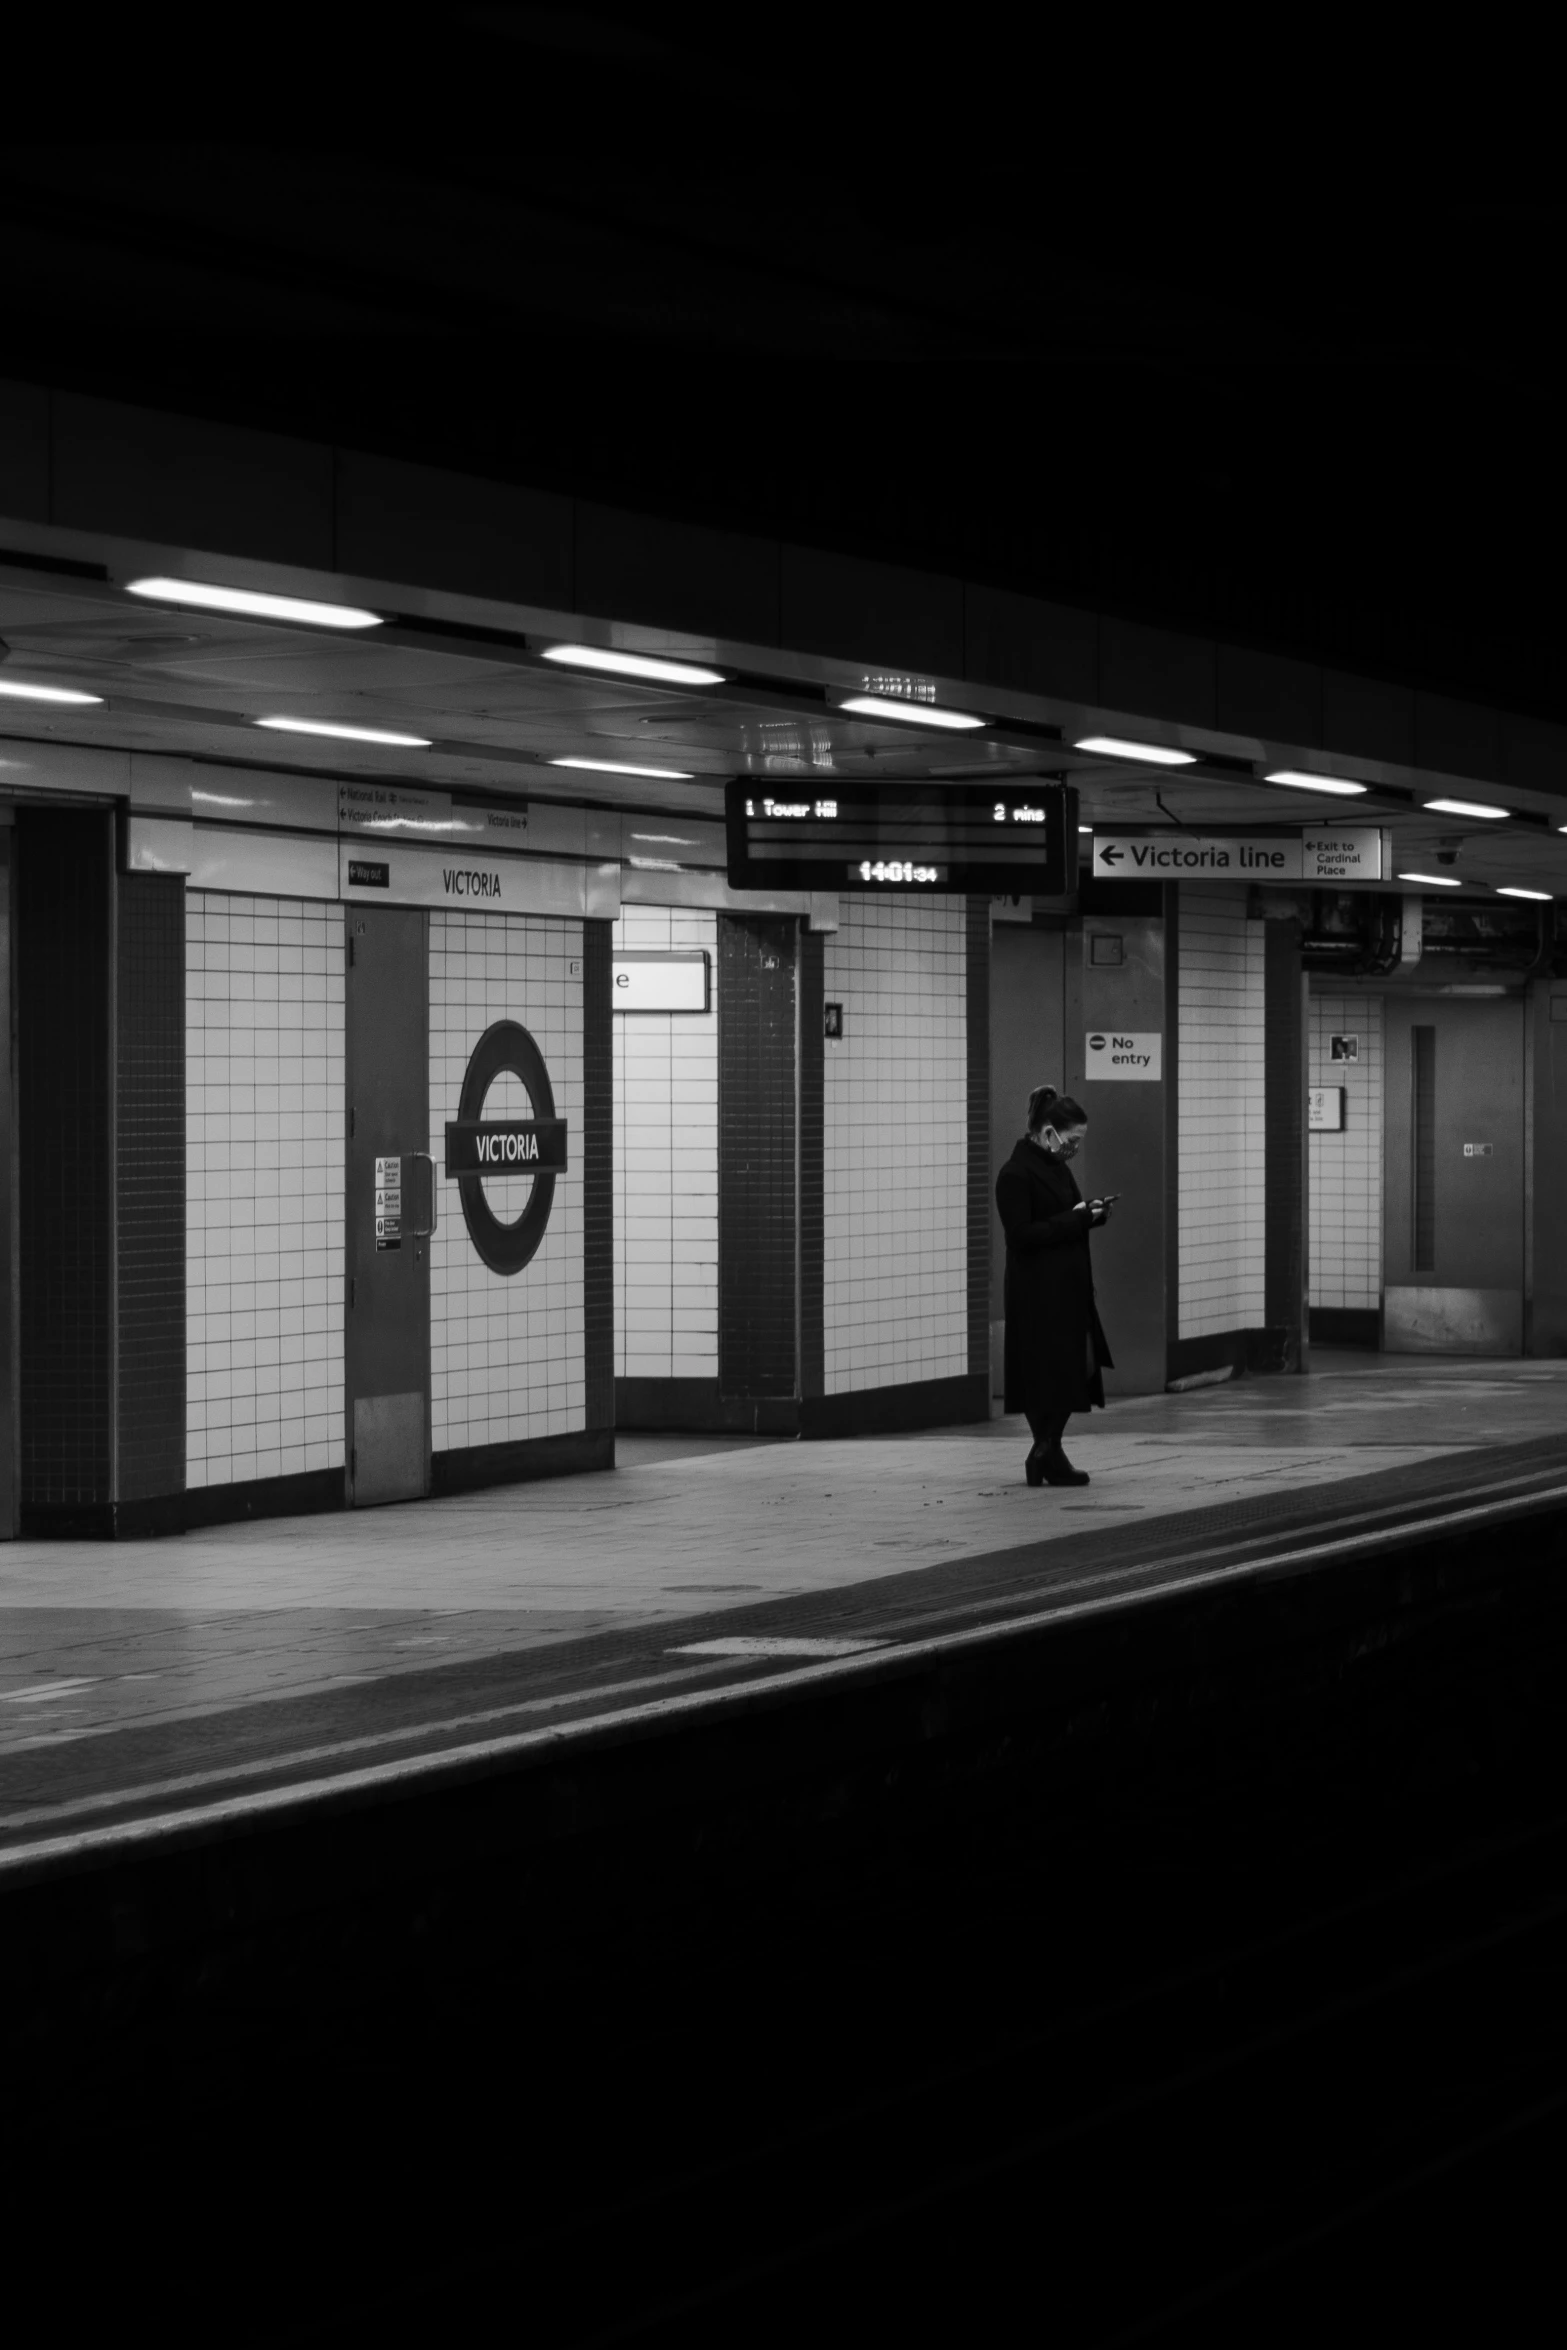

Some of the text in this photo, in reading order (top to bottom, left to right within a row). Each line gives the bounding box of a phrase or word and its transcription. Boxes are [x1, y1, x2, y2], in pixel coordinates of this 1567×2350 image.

[763, 799, 810, 817] Tower
[815, 800, 838, 817] Hill
[993, 803, 1006, 821] 2
[1013, 804, 1046, 822] mins
[1316, 841, 1355, 851] Exit to
[1130, 845, 1286, 868] Victoria line
[1316, 853, 1361, 864] Cardinal
[355, 864, 382, 882] Way out
[1316, 865, 1346, 876] Place
[443, 869, 501, 897] VICTORIA
[1112, 1037, 1134, 1049] No
[1111, 1054, 1151, 1068] entry
[475, 1133, 539, 1162] VICTORIA
